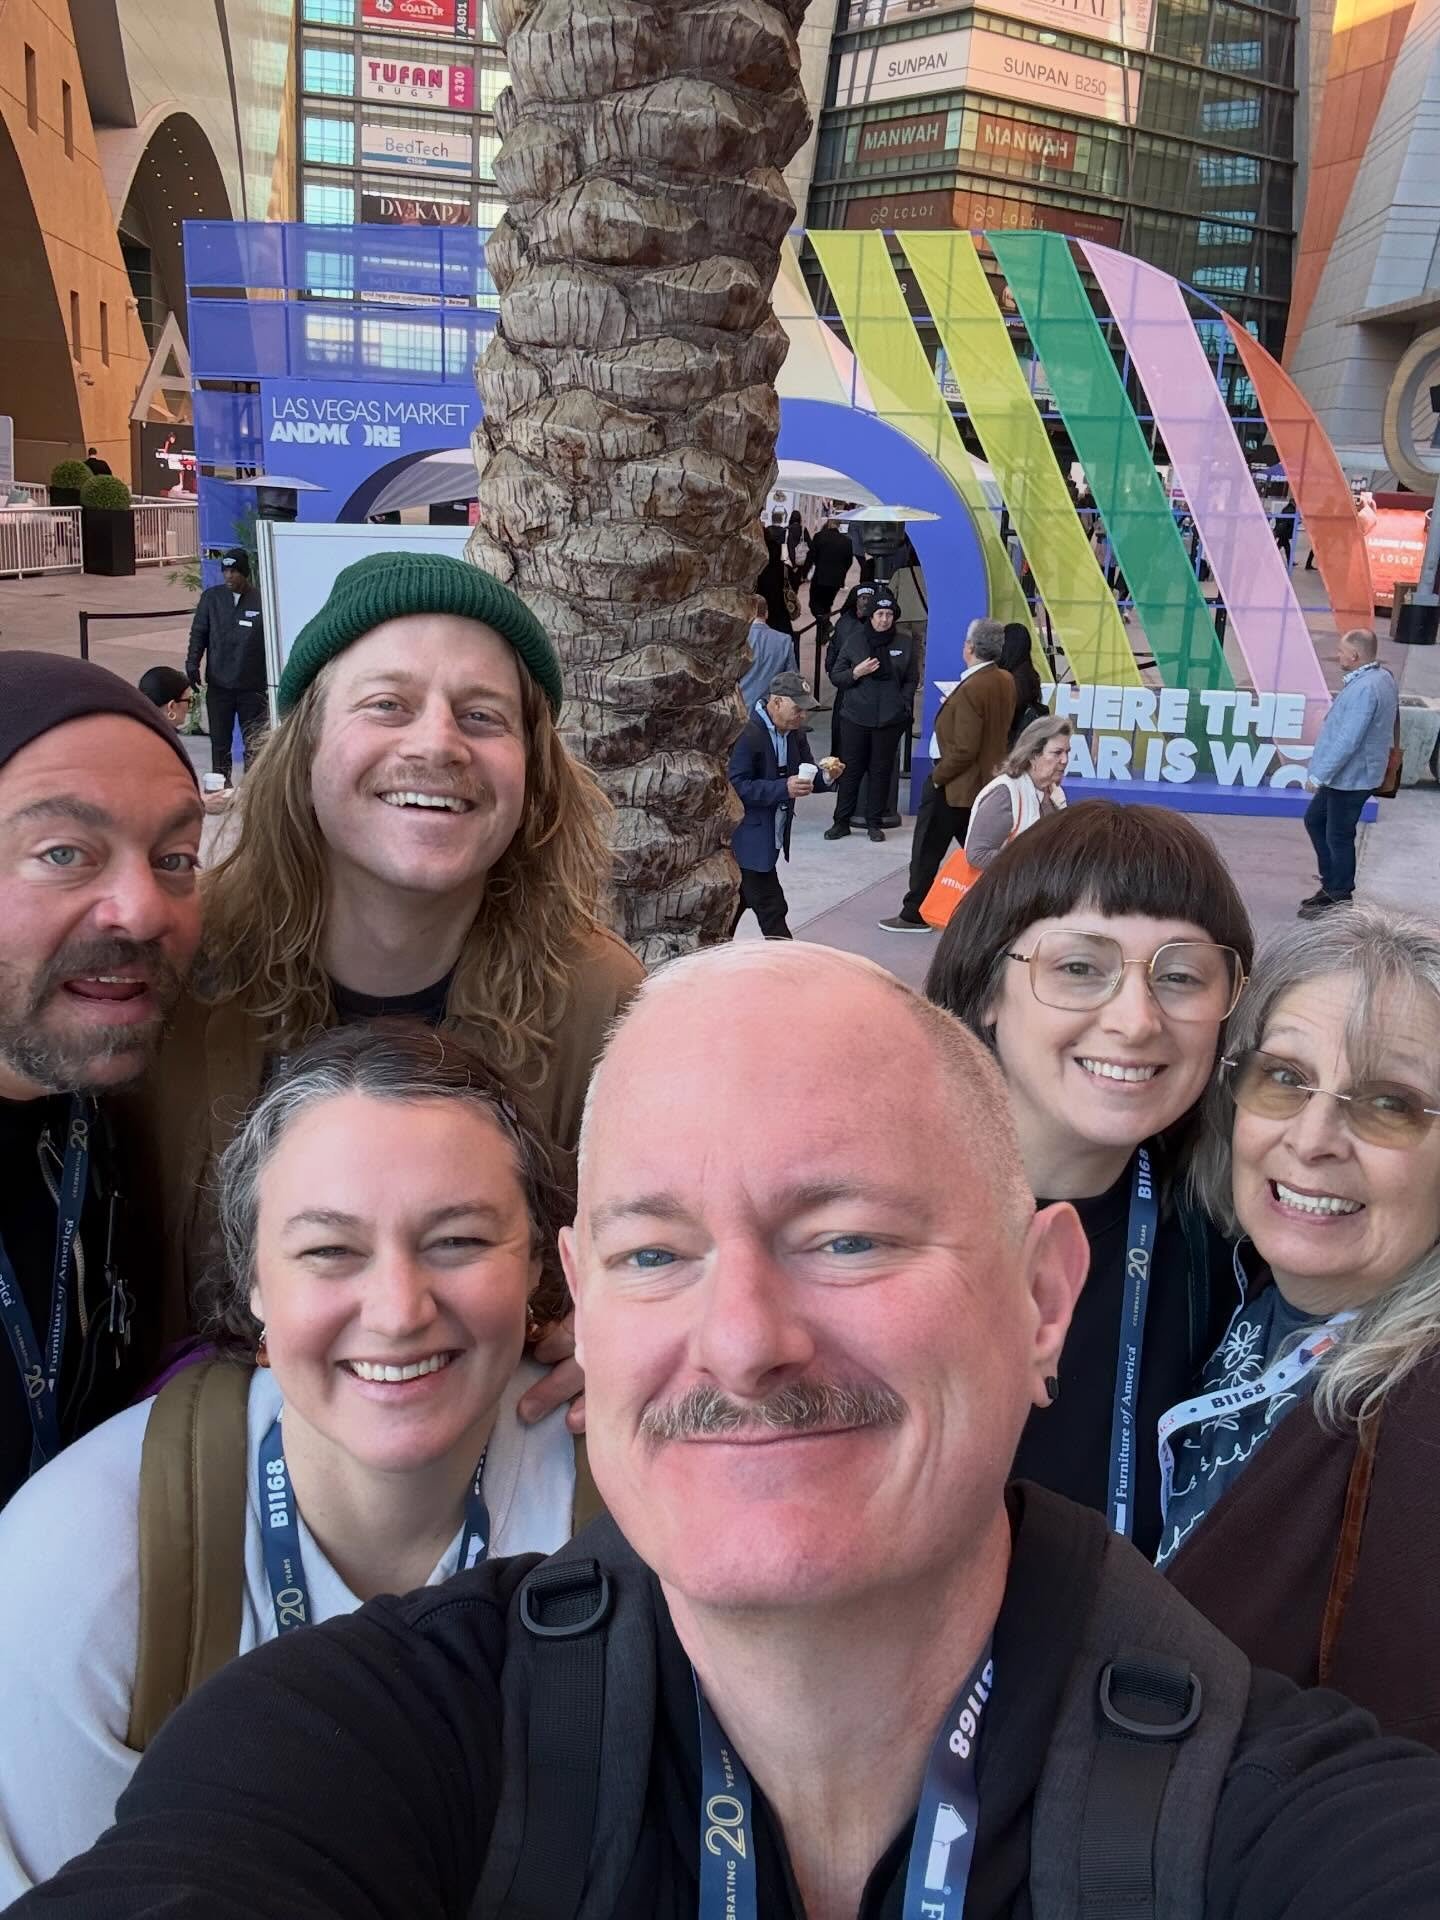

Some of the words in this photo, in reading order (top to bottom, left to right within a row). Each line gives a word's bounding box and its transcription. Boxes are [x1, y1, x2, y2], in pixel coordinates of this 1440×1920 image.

[400, 3, 444, 17] COASTER
[456, 2, 468, 33] A801
[368, 62, 443, 89] TUFAN
[888, 52, 948, 77] SUNPAN
[1003, 57, 1068, 87] SUNPAN
[1076, 74, 1107, 96] B250
[385, 137, 449, 157] BedTech
[864, 123, 939, 150] MANWAH
[985, 124, 1069, 159] MANWAH
[894, 205, 934, 219] LOLOI
[272, 397, 308, 420] LAS
[312, 399, 381, 423] VEGAS
[385, 401, 470, 427] MARKET
[1040, 682, 1190, 733] HERE
[1200, 689, 1306, 739] THE
[1064, 733, 1133, 781] AR
[1144, 737, 1198, 784] IS
[70, 1119, 88, 1152] 20
[58, 1219, 75, 1281] America
[1127, 1247, 1149, 1281] 20
[24, 1365, 46, 1399] 20
[1121, 1345, 1137, 1407] America
[1211, 1382, 1266, 1409] B1168
[1122, 1407, 1133, 1424] of
[1115, 1425, 1131, 1498] Furniture
[266, 1458, 289, 1529] B1168
[284, 1558, 292, 1584] YEARS
[276, 1587, 306, 1626] 20
[721, 1749, 735, 1788] YEARS
[705, 1794, 747, 1860] 20
[726, 1860, 737, 1920] BRATING
